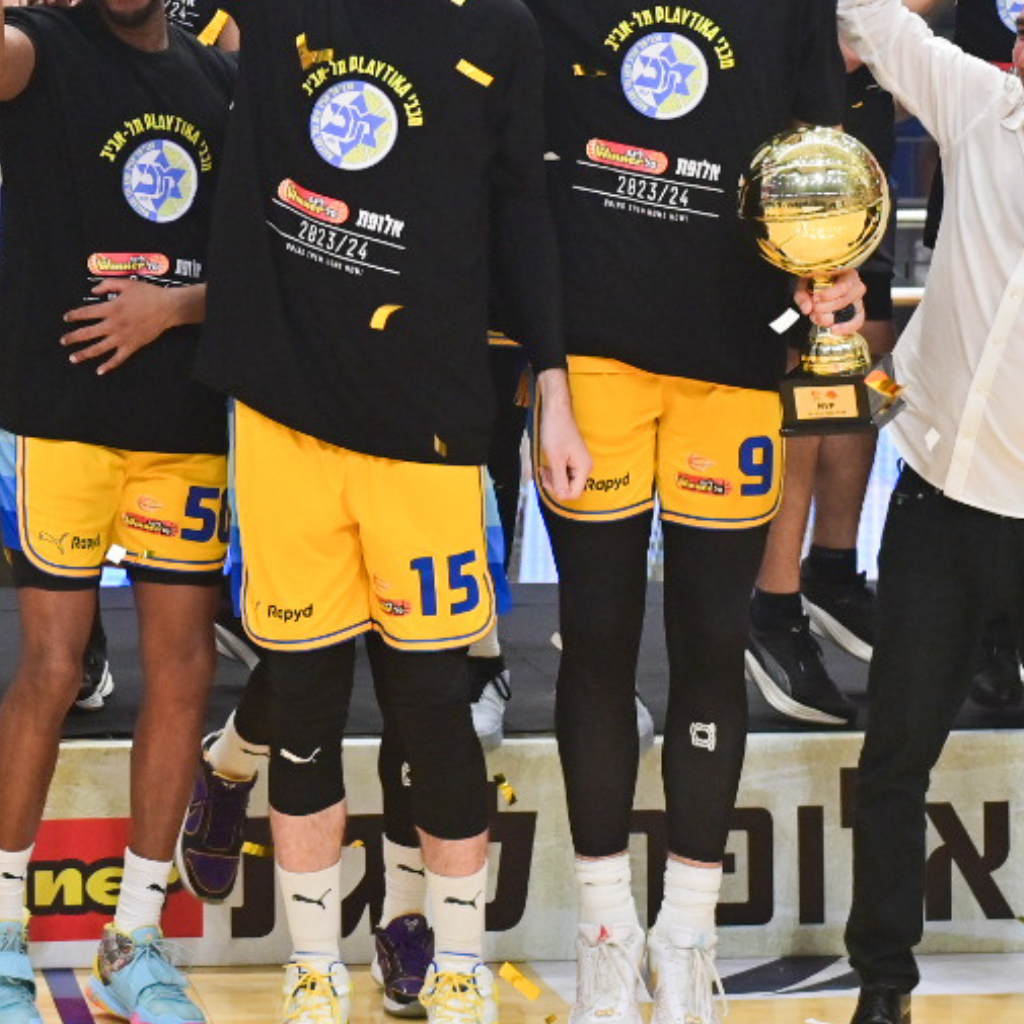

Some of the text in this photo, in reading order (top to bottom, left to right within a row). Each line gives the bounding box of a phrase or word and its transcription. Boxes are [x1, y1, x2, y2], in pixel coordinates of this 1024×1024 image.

[604, 5, 736, 70] מכבי PLAYTIKA תל-אביב
[349, 56, 413, 98] PLAYTIKA
[144, 113, 201, 148] PLAYTIKA
[675, 157, 722, 182] אלופת
[617, 176, 690, 208] 2023/24
[298, 220, 369, 260] 2023/24
[355, 209, 406, 238] אלופת
[739, 435, 774, 497] 9
[410, 549, 480, 617] 15
